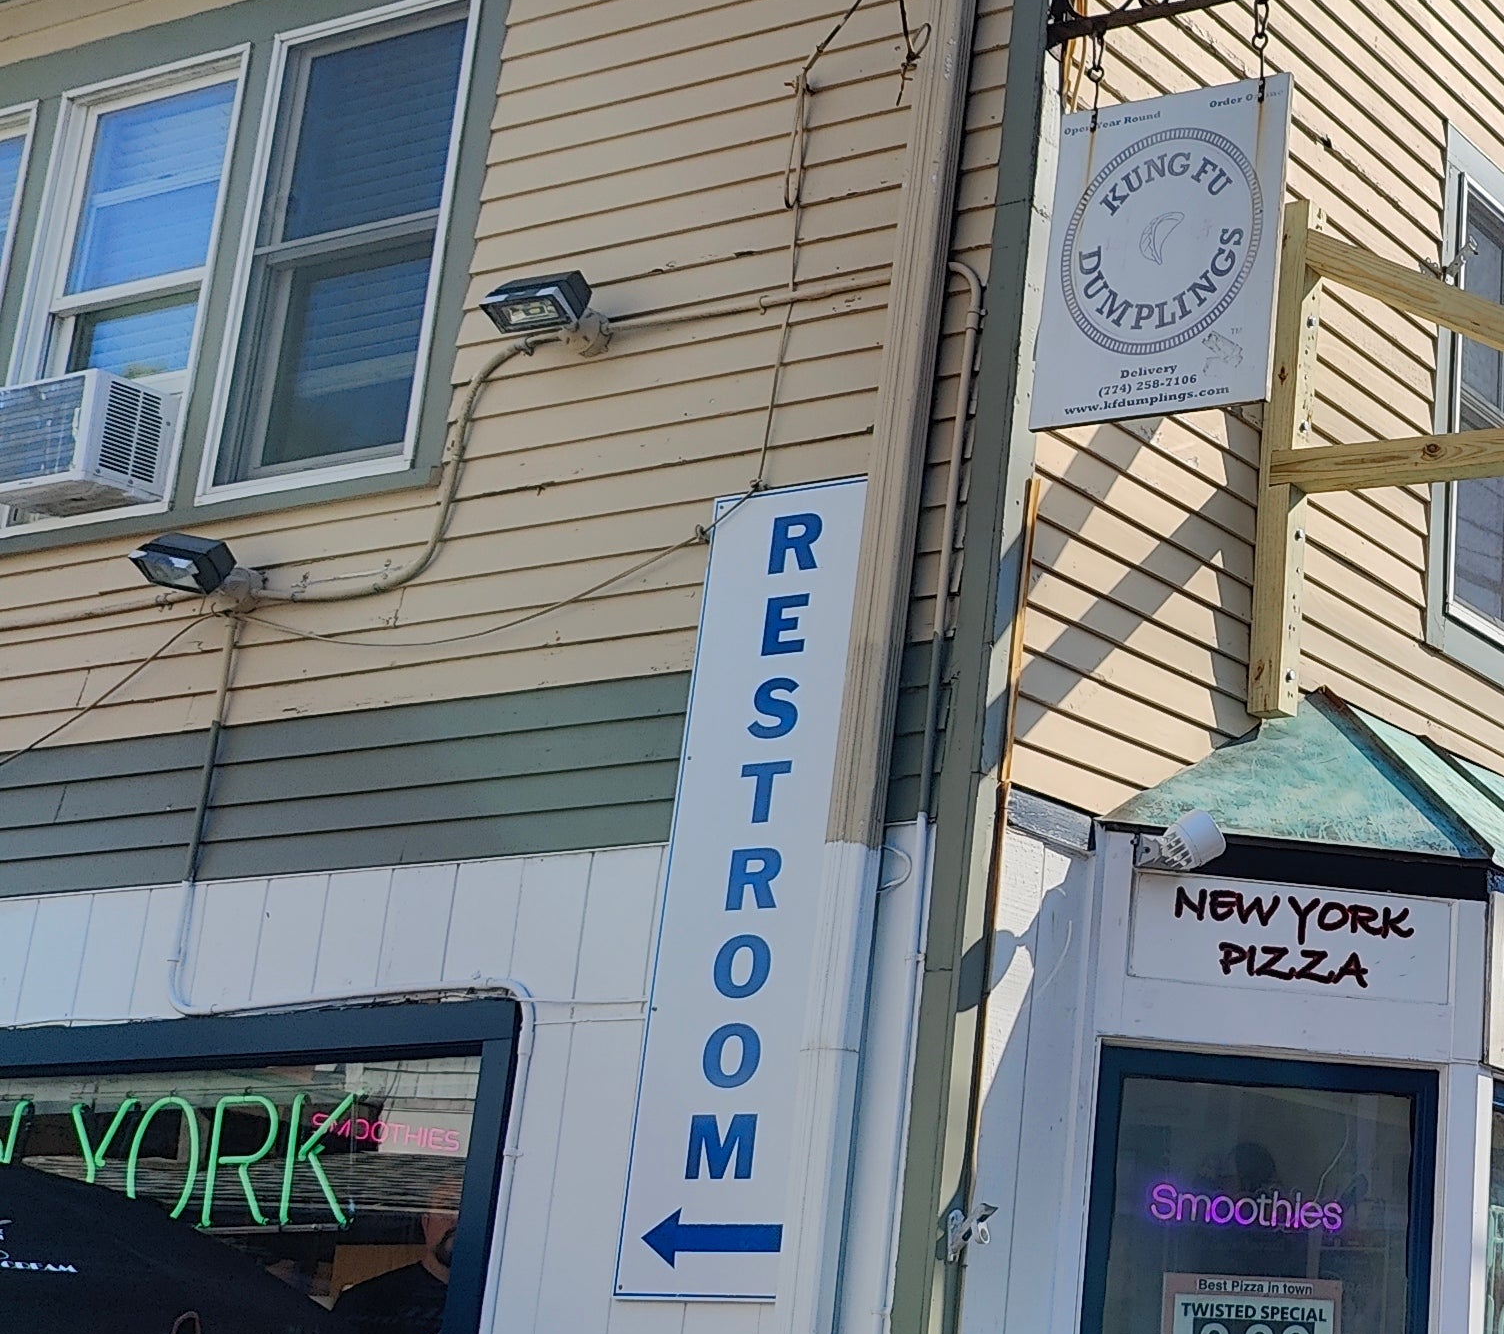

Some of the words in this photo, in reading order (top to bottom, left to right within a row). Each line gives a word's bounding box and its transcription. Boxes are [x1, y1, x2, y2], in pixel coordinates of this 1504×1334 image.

[1123, 111, 1161, 126] Round
[1209, 96, 1242, 109] Order
[1099, 152, 1191, 216] KUNG
[1191, 156, 1233, 197] FU
[1079, 227, 1244, 330] DUMPLINGS
[1099, 383, 1132, 398] (774)
[1136, 374, 1197, 392] 258-7106
[1120, 364, 1178, 380] Delivery
[1064, 386, 1230, 415] www.kfdumplings.com
[684, 512, 823, 1181] RESTROOM
[1174, 885, 1281, 928] NEW
[1287, 894, 1415, 946] YORK
[1218, 941, 1369, 988] PIZZA
[71, 1090, 367, 1228] YORK
[1150, 1182, 1344, 1231] Smoothies
[1198, 1278, 1228, 1292] Best
[1231, 1280, 1264, 1293] Pizza
[1282, 1283, 1313, 1296] town
[1180, 1302, 1257, 1319] TWISTED
[1260, 1305, 1327, 1323] SPECIAL
